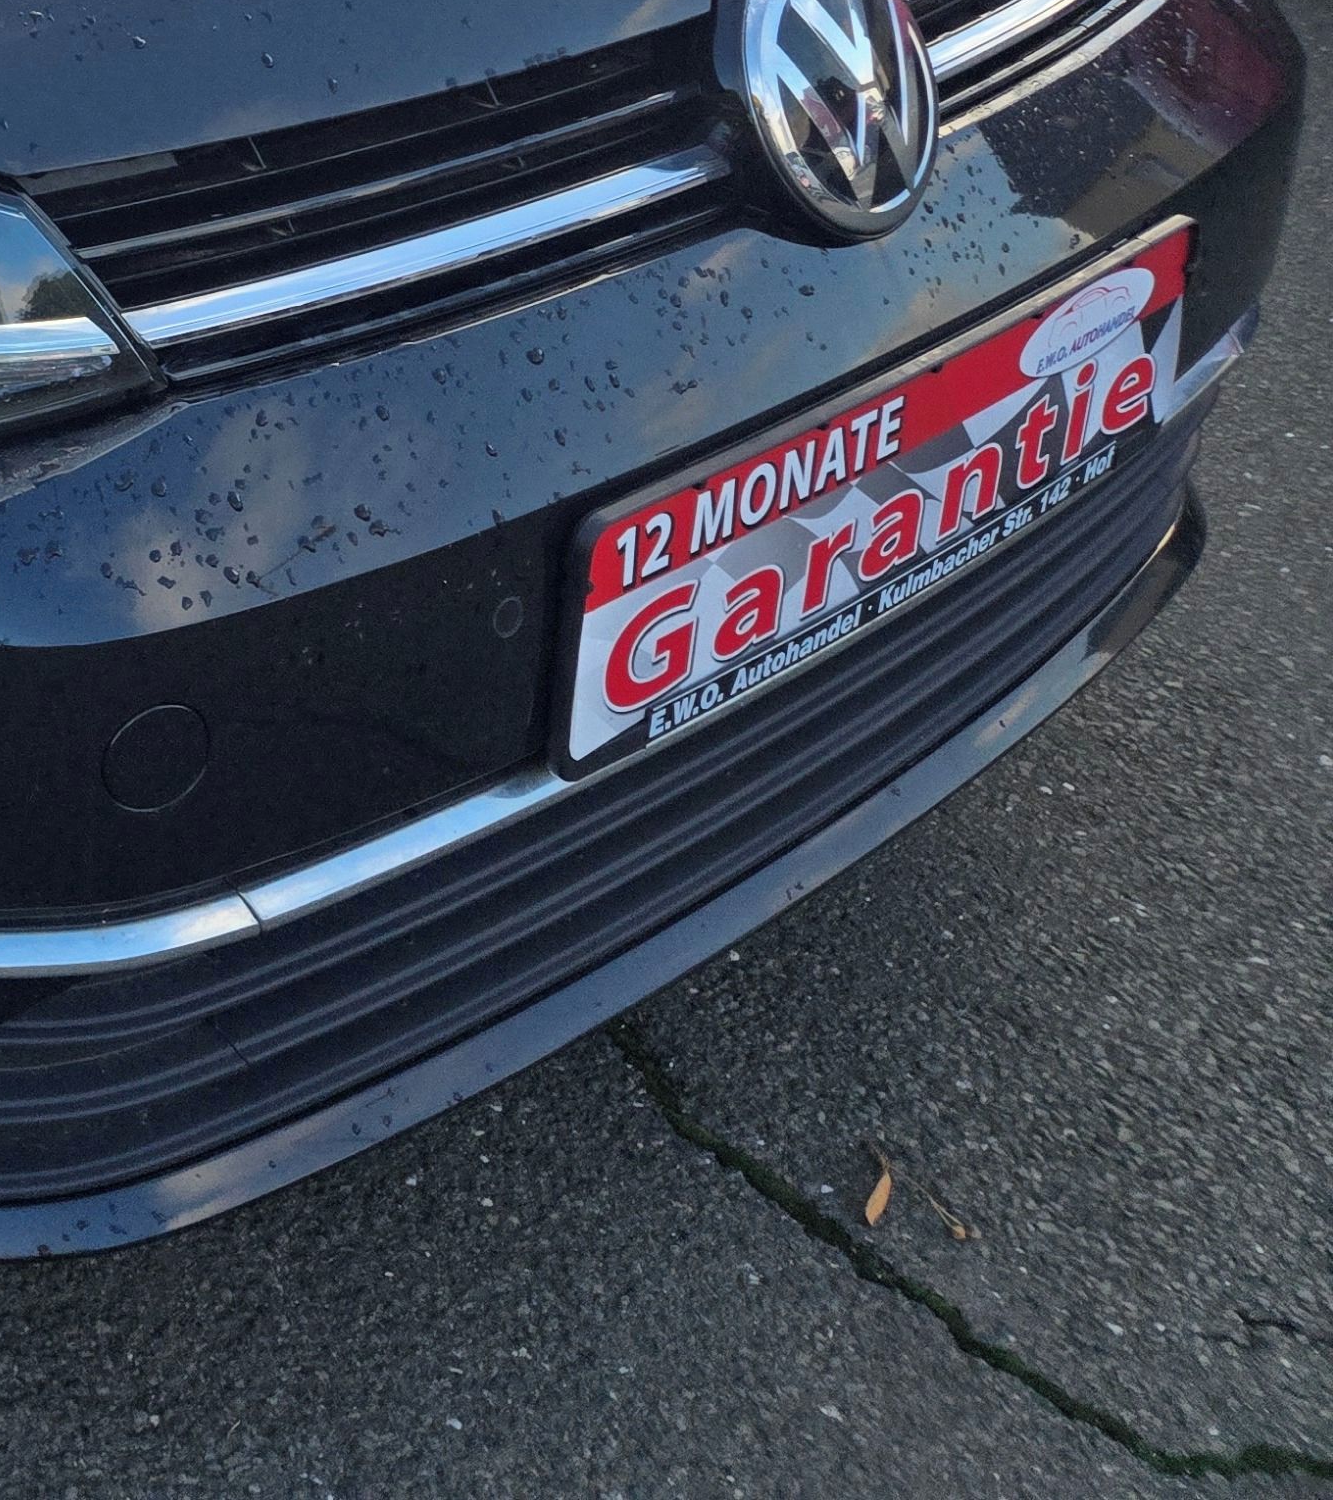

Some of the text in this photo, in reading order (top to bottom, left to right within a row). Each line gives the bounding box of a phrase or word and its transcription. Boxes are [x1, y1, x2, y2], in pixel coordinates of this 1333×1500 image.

[1036, 306, 1136, 375] E.W.O. AUTOHANDEL
[603, 351, 1158, 714] Garantie
[616, 395, 907, 588] 12 MONATE
[648, 444, 1117, 739] E.W.O. Autohandel Kulmbacher Str. 142 Hof
